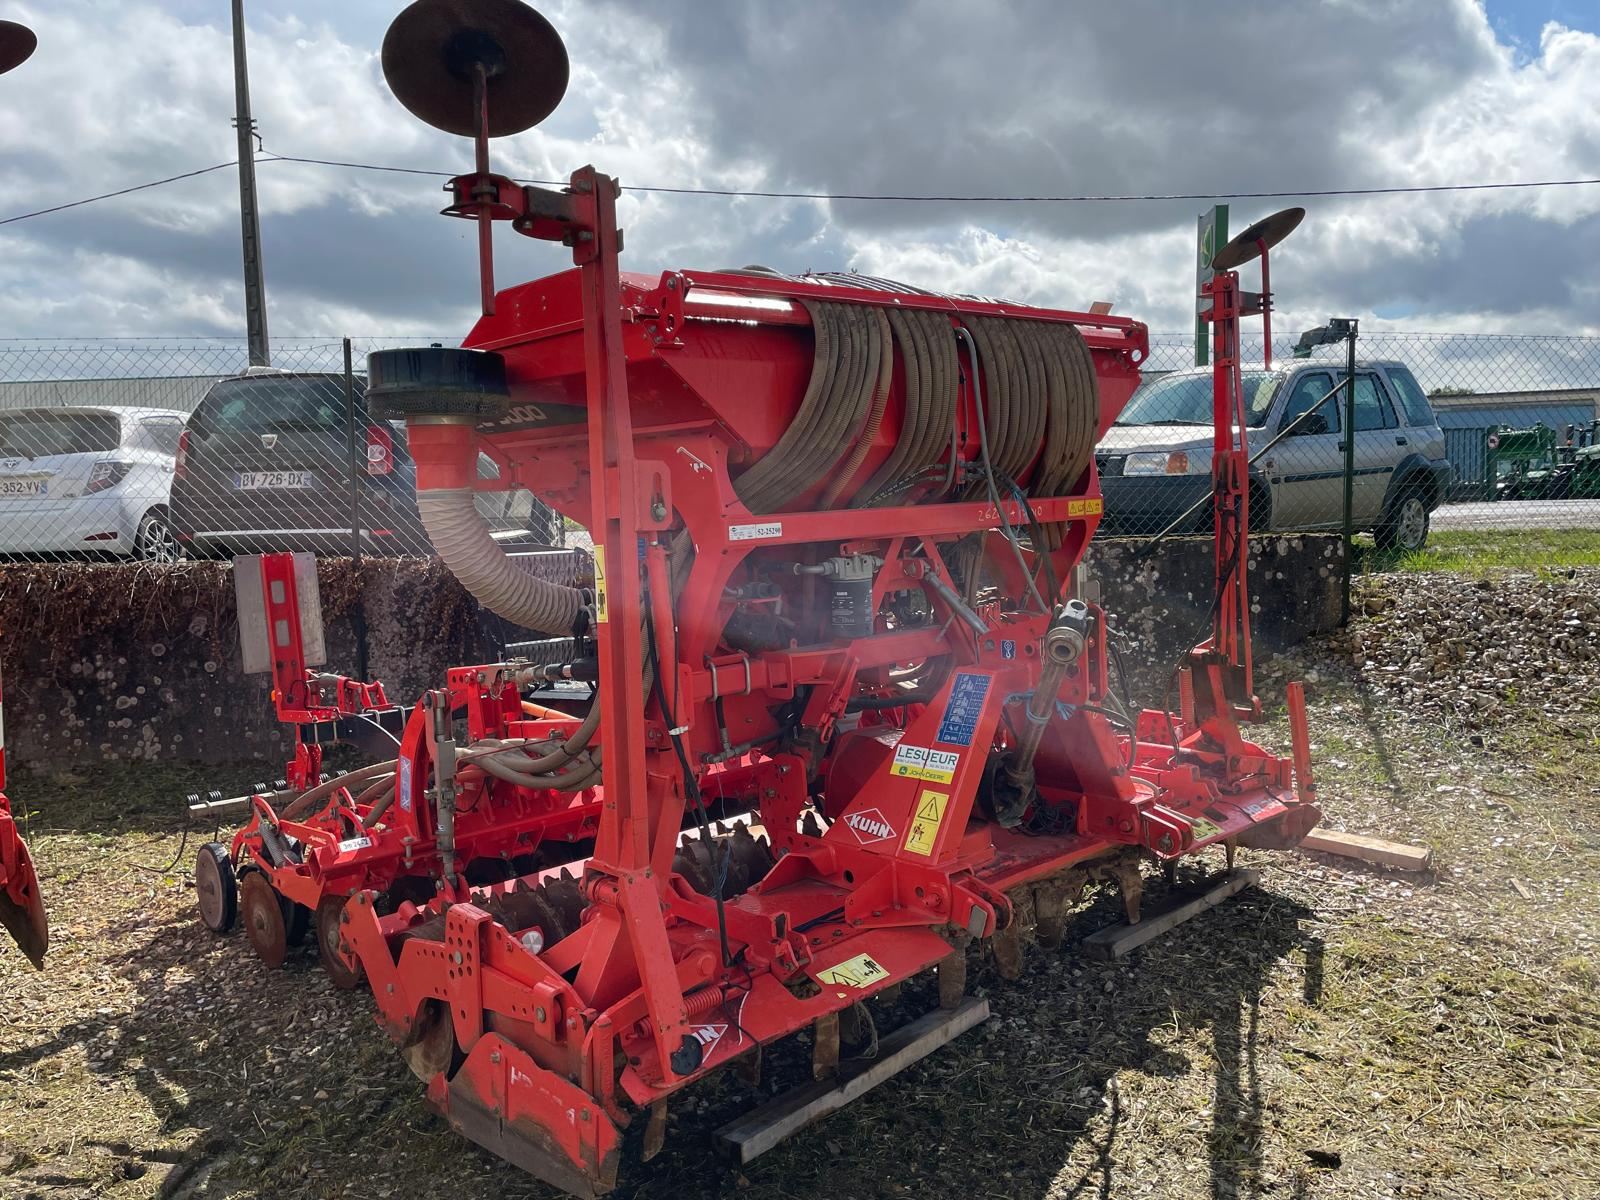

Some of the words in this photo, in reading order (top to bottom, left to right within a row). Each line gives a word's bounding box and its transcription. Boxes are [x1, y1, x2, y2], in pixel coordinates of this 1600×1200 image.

[242, 473, 304, 487] BV-726-DX
[897, 746, 957, 766] LESUEUR
[925, 771, 944, 780] DEERE
[849, 814, 890, 839] KUHN
